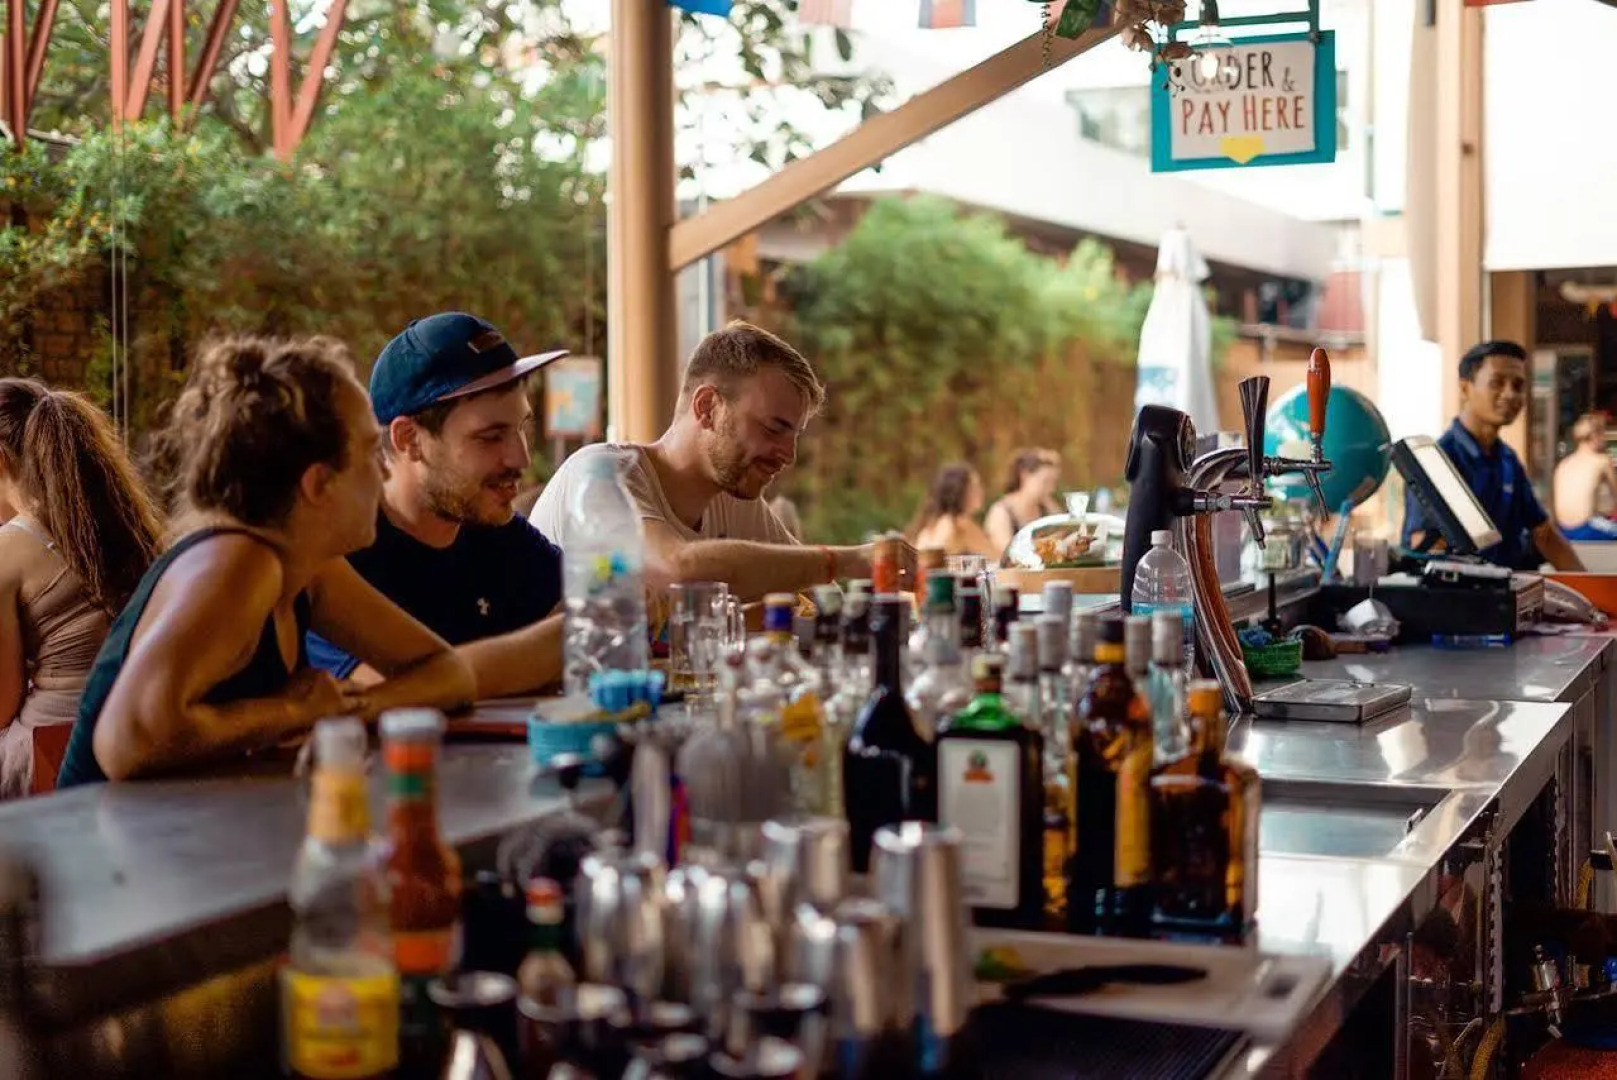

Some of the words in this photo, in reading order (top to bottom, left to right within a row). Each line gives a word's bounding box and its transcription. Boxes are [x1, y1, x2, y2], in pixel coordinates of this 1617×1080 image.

[1282, 66, 1296, 92] &
[1182, 98, 1231, 135] PAY
[1243, 95, 1305, 131] HERE
